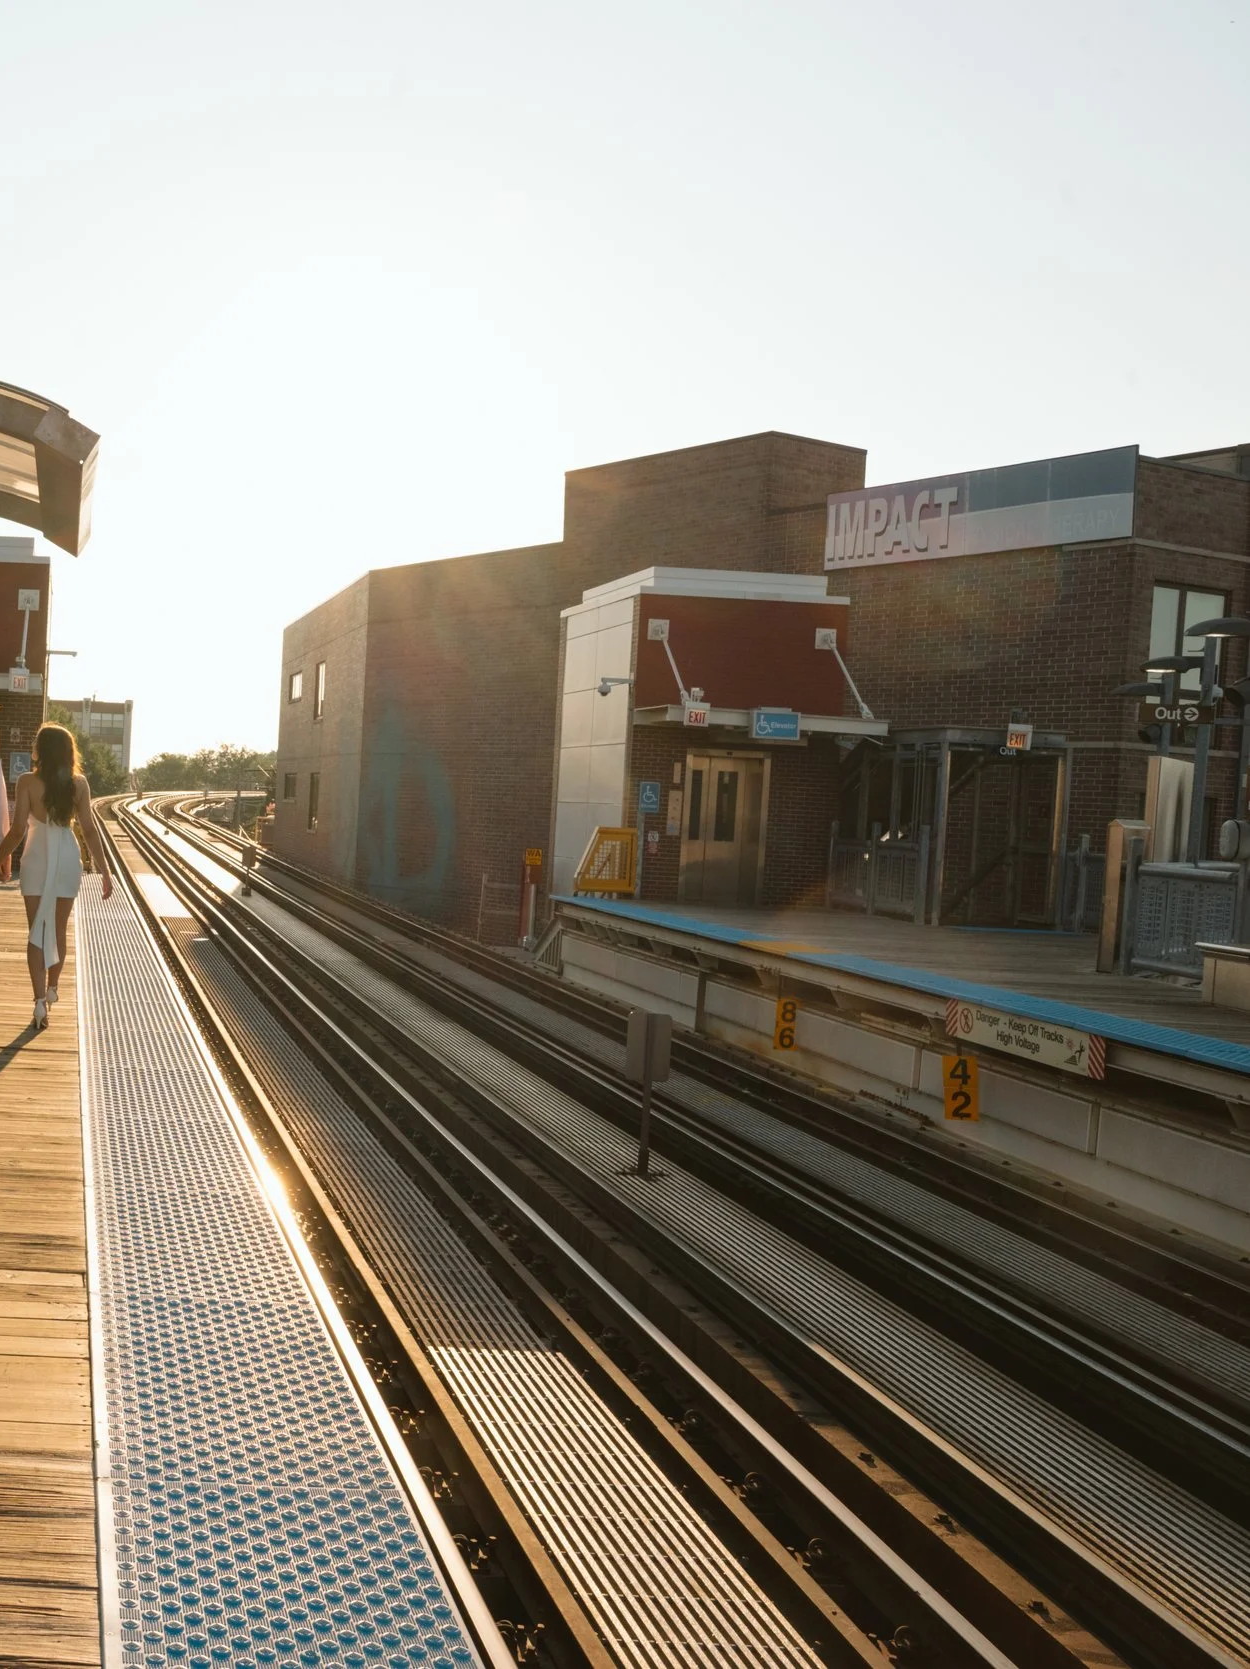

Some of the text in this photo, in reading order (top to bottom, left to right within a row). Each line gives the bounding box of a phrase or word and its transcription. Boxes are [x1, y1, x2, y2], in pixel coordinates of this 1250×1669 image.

[826, 487, 958, 561] IMPACT
[13, 677, 27, 689] EXIT
[688, 711, 706, 725] EXIT
[1155, 707, 1182, 721] Out
[770, 722, 797, 730] Elevator
[1009, 733, 1027, 746] EXIT
[782, 1001, 797, 1022] 8
[779, 1027, 795, 1048] 6
[975, 1010, 1000, 1027] Danger
[1008, 1016, 1027, 1036] Keep
[1028, 1022, 1040, 1037] Off
[1040, 1026, 1064, 1045] Tracks
[996, 1030, 1040, 1054] High Voltage
[949, 1058, 971, 1085] 4
[951, 1091, 972, 1118] 2
